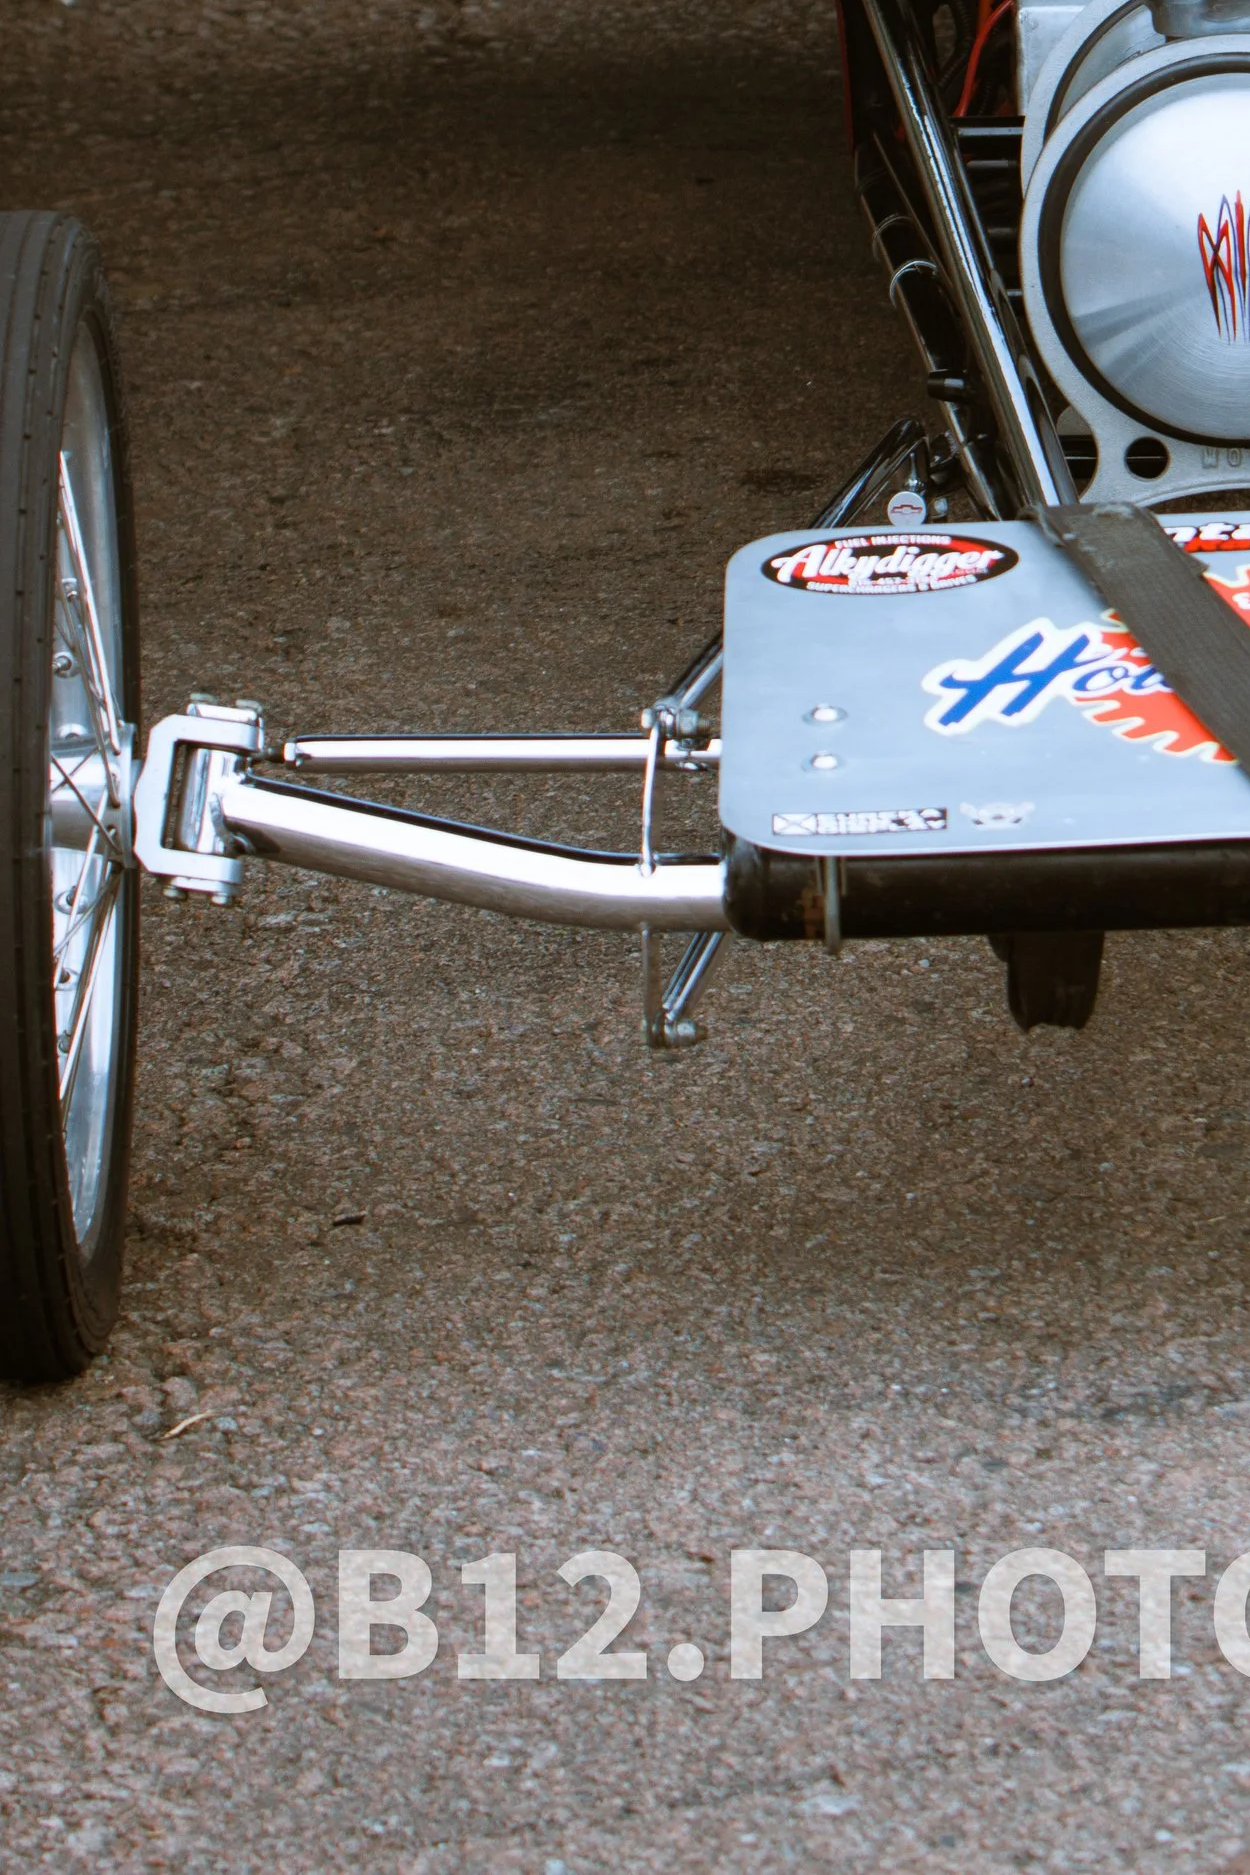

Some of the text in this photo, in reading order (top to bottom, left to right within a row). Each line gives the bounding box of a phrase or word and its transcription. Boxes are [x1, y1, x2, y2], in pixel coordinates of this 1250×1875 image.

[834, 534, 952, 549] FUEL INJECTIONS
[771, 545, 1005, 584] Alkydigger
